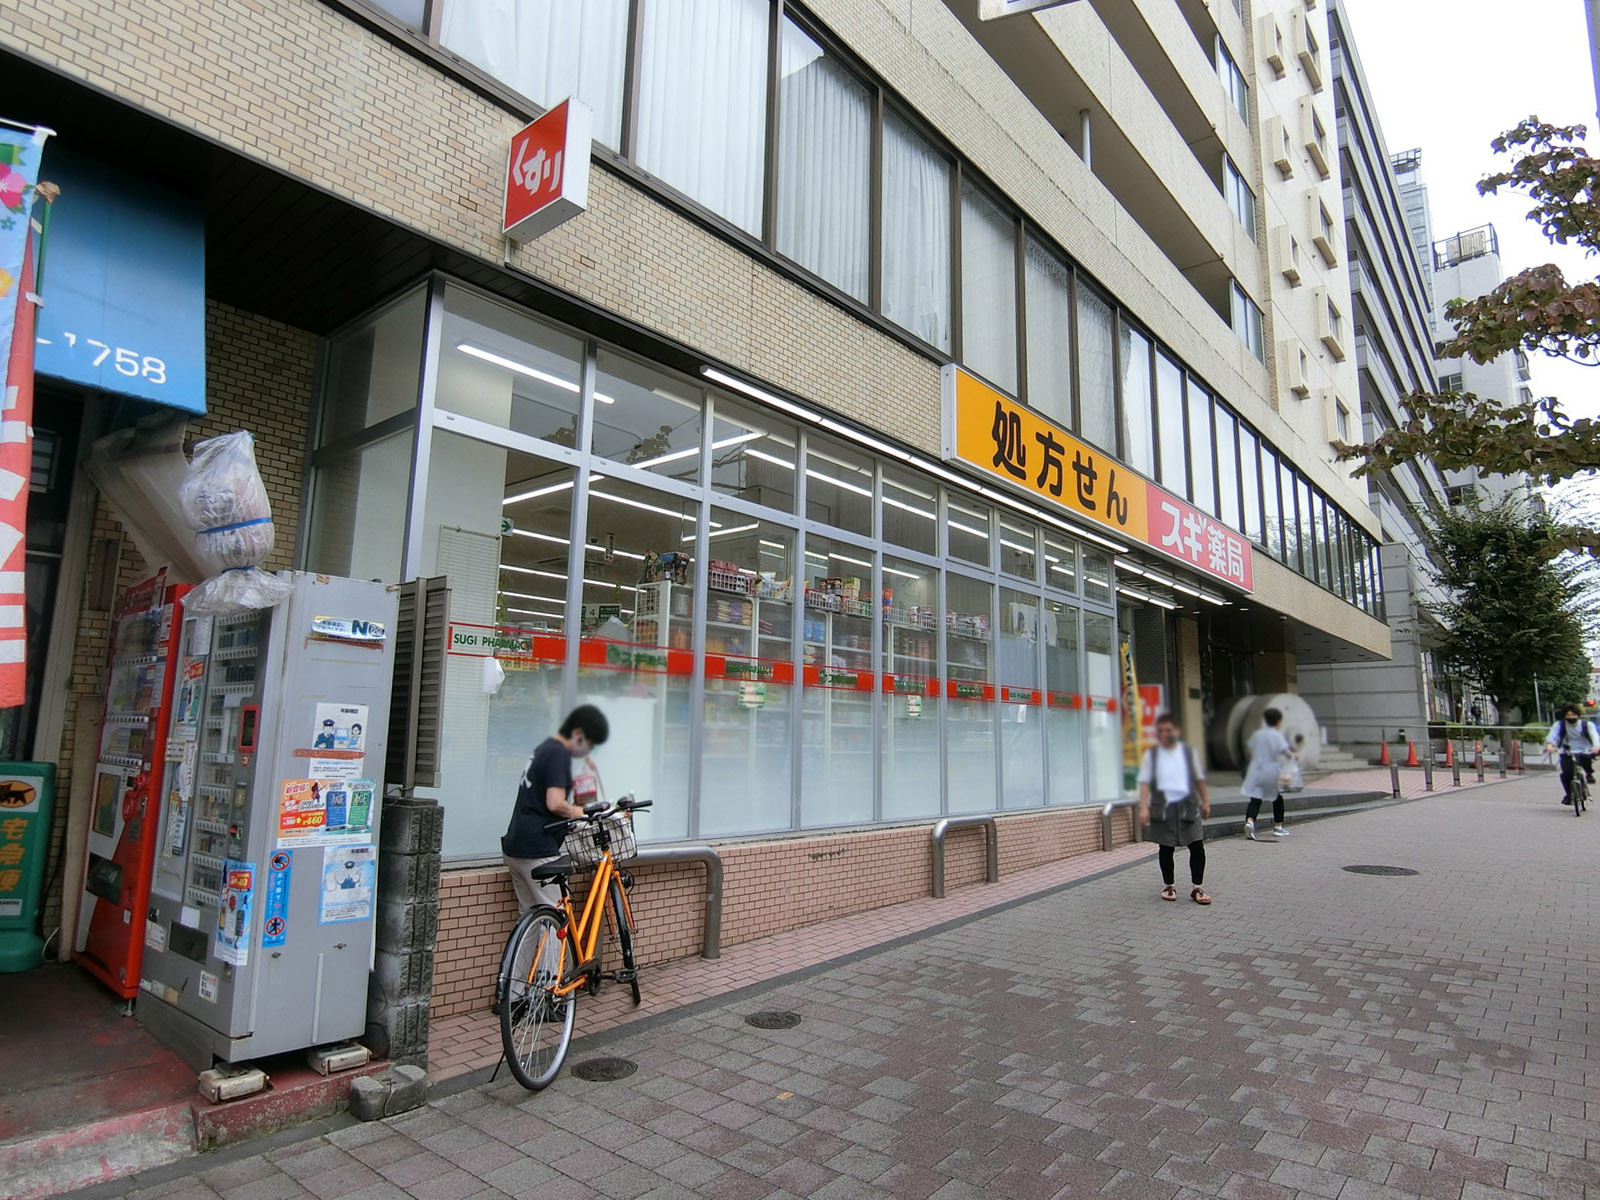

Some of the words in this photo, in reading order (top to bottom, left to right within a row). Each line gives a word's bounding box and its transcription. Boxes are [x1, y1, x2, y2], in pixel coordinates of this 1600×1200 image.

[512, 137, 562, 196] くすり
[991, 400, 1127, 526] 処方せん
[1161, 501, 1244, 583] スギ薬局
[454, 633, 478, 646] SUGI
